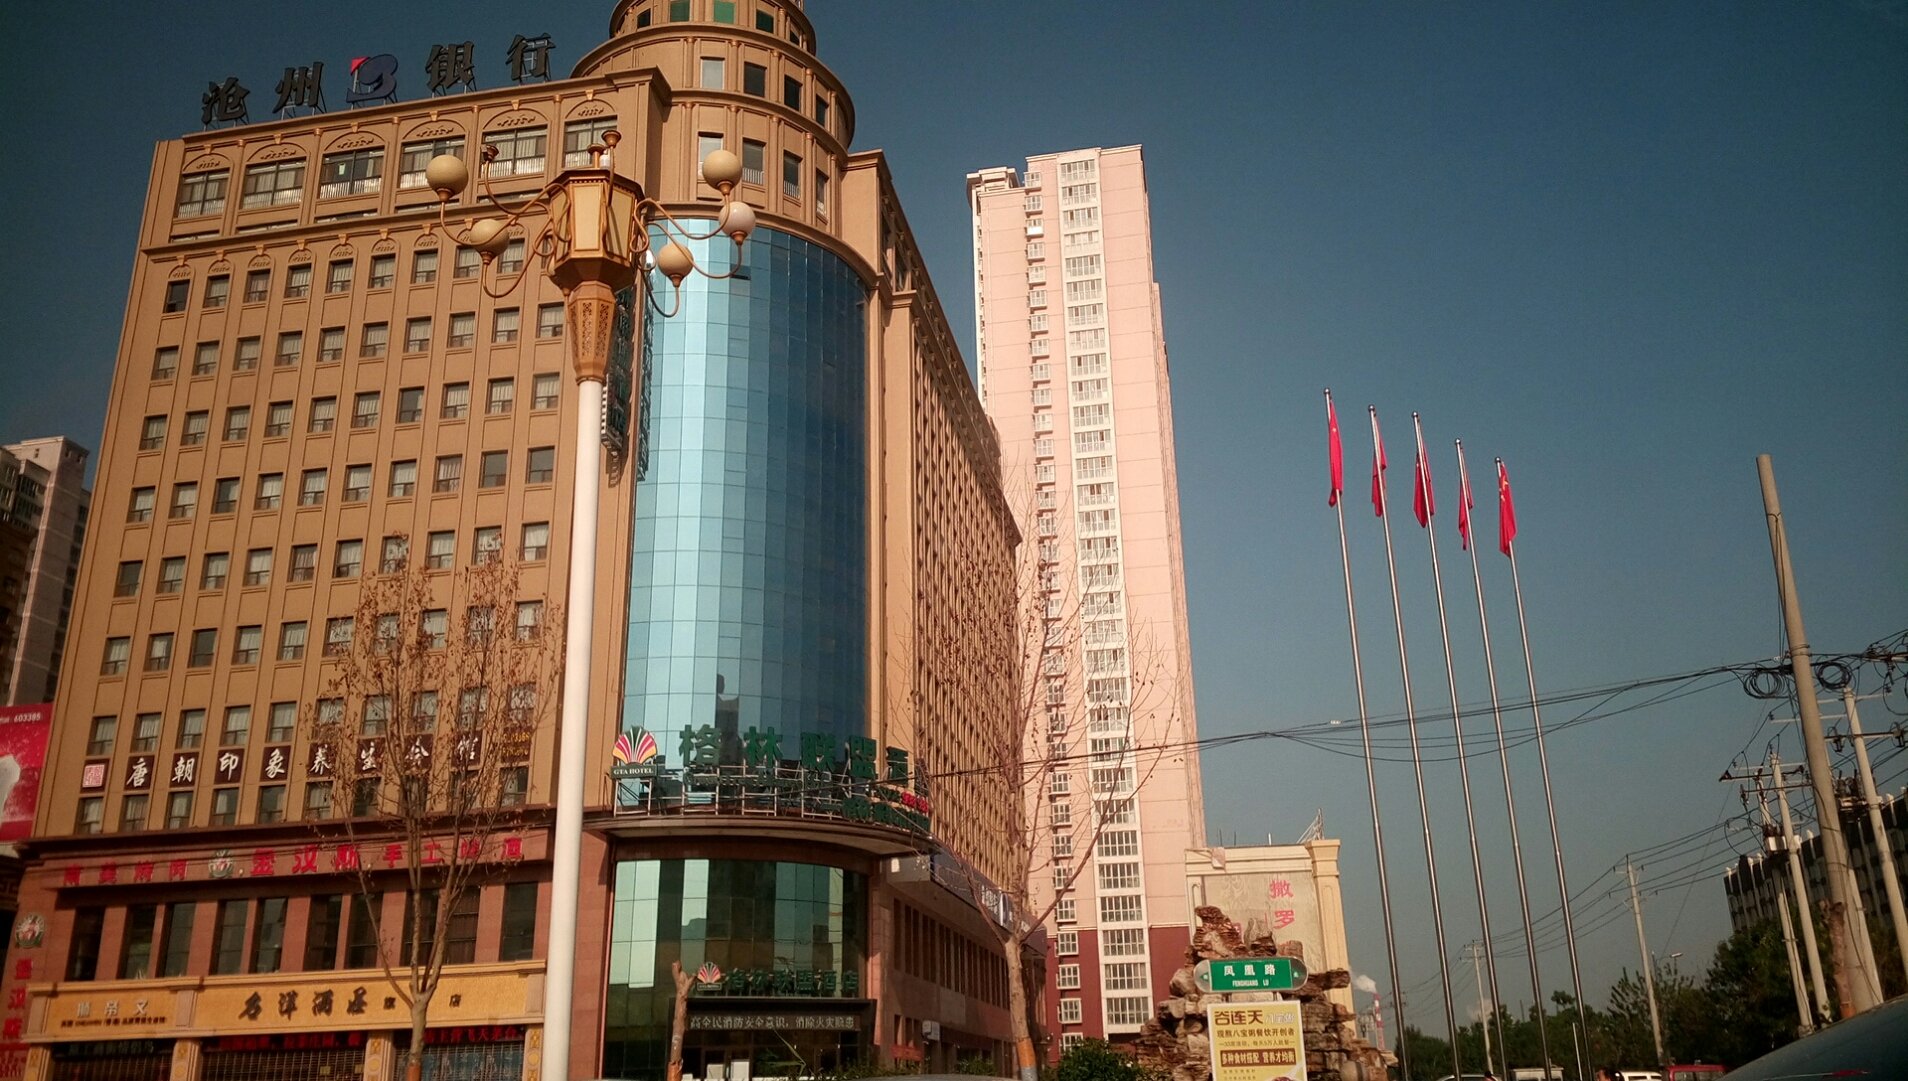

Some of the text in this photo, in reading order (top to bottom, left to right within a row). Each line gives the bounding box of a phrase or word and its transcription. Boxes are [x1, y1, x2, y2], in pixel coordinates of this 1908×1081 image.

[425, 32, 556, 91] 银行
[679, 724, 928, 797] 格林联盟酒
[629, 767, 654, 775] HOTEL
[1223, 963, 1276, 977] 凤凰路
[1214, 1010, 1264, 1026] 谷连天
